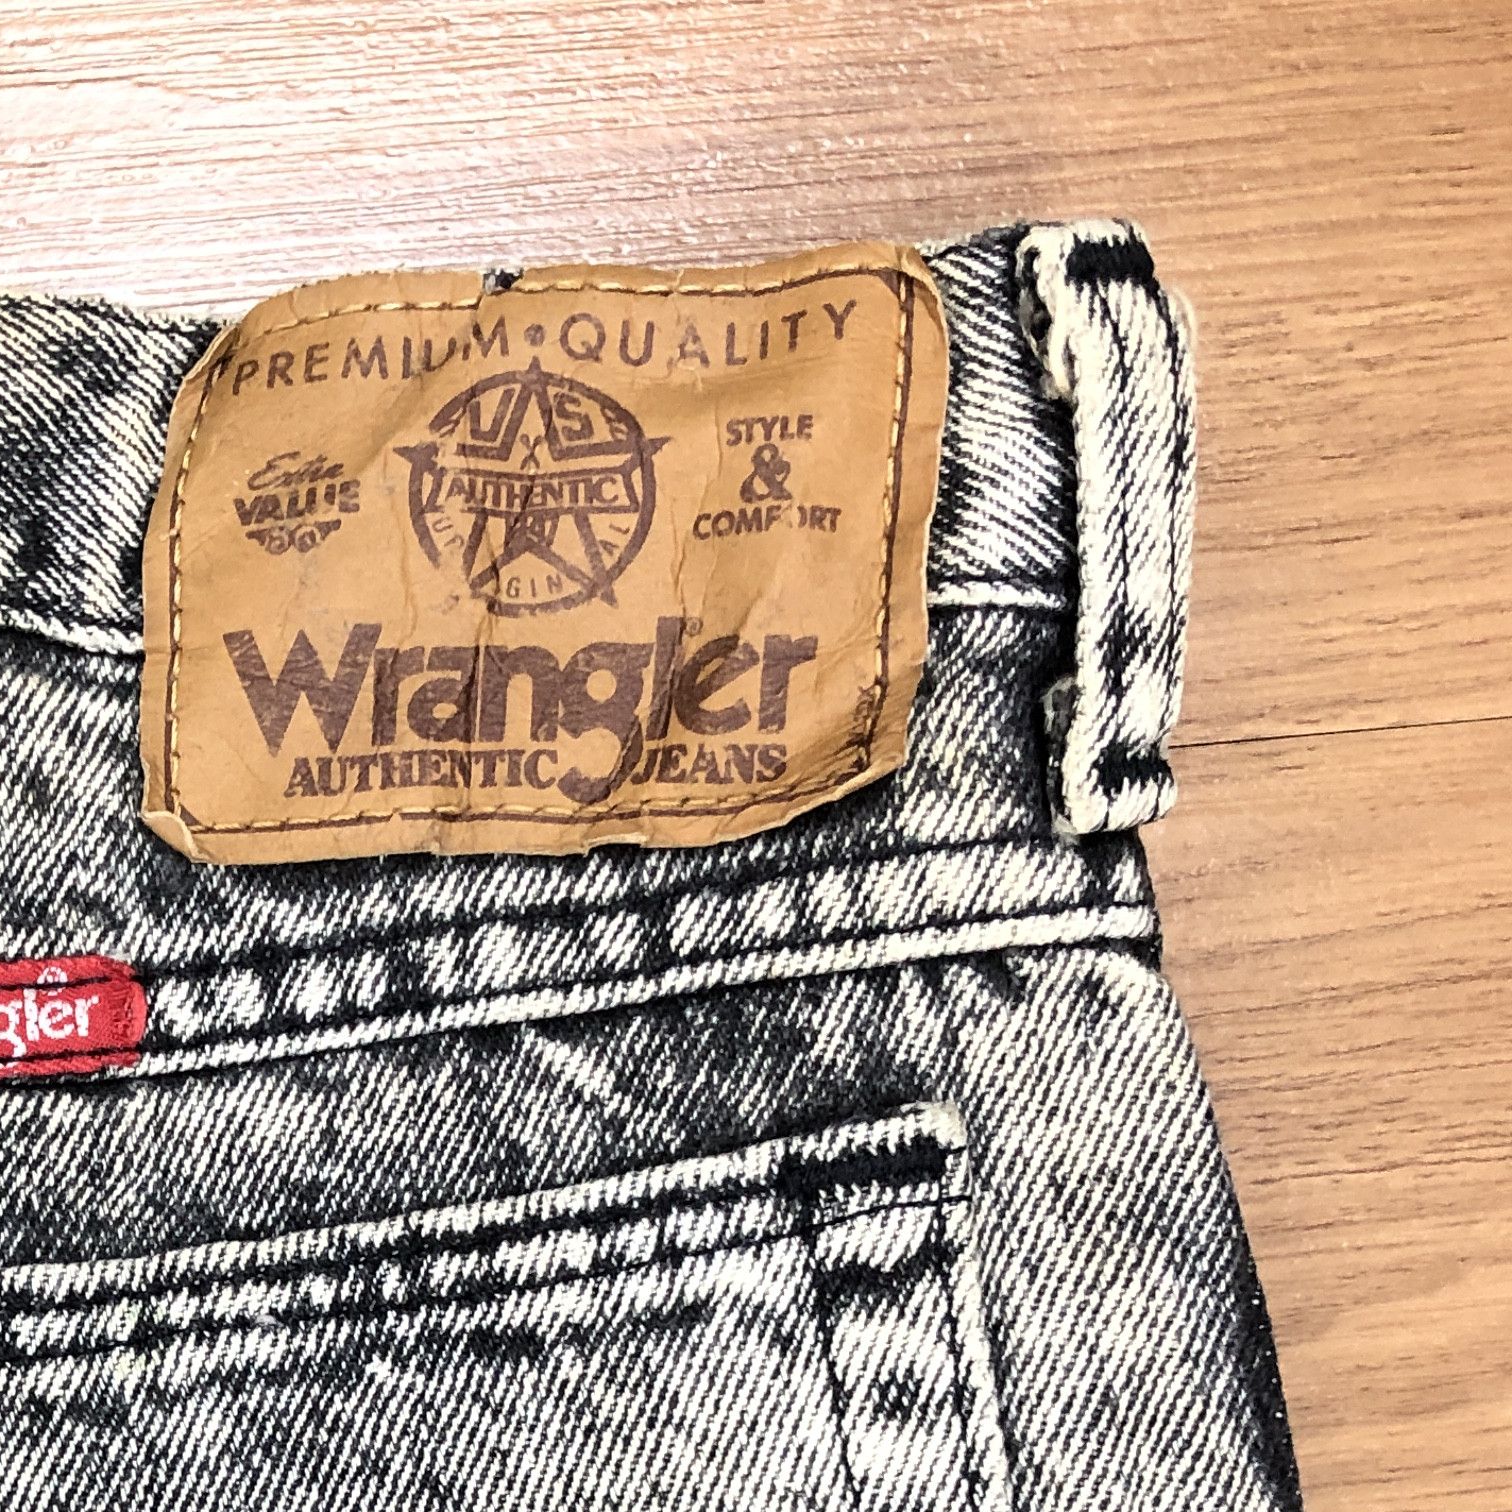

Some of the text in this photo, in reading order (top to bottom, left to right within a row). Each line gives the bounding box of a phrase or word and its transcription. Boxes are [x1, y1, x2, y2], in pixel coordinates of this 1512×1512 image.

[231, 298, 858, 396] PREMIUM QUALITY
[725, 413, 814, 447] STYLE
[444, 475, 620, 508] AUTHENTIC
[739, 442, 793, 504] &
[232, 478, 361, 526] VALUE
[222, 615, 819, 804] Wrangler
[283, 742, 788, 799] AUTHENTIC JEANS
